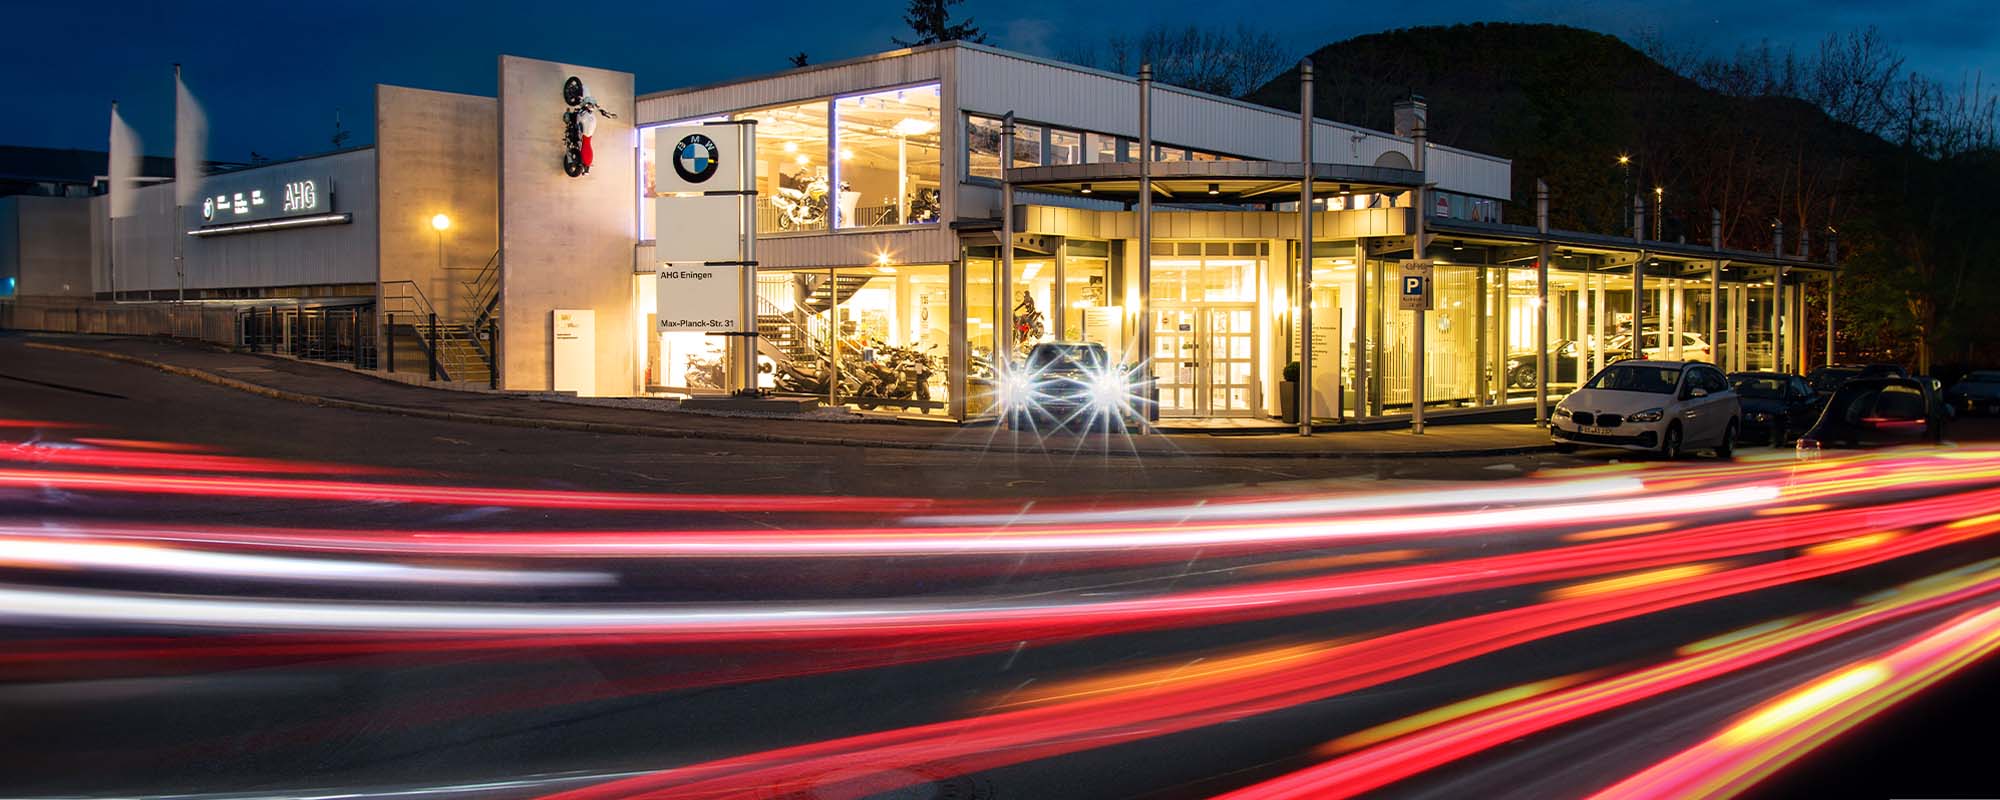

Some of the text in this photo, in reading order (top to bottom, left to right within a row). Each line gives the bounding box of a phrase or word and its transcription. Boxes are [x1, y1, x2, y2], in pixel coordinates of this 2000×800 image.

[677, 135, 715, 151] BMW
[283, 180, 316, 212] AHG
[660, 271, 713, 281] AHG Eningen
[1407, 278, 1419, 293] P
[660, 319, 734, 328] Max-Planck-Str. 31
